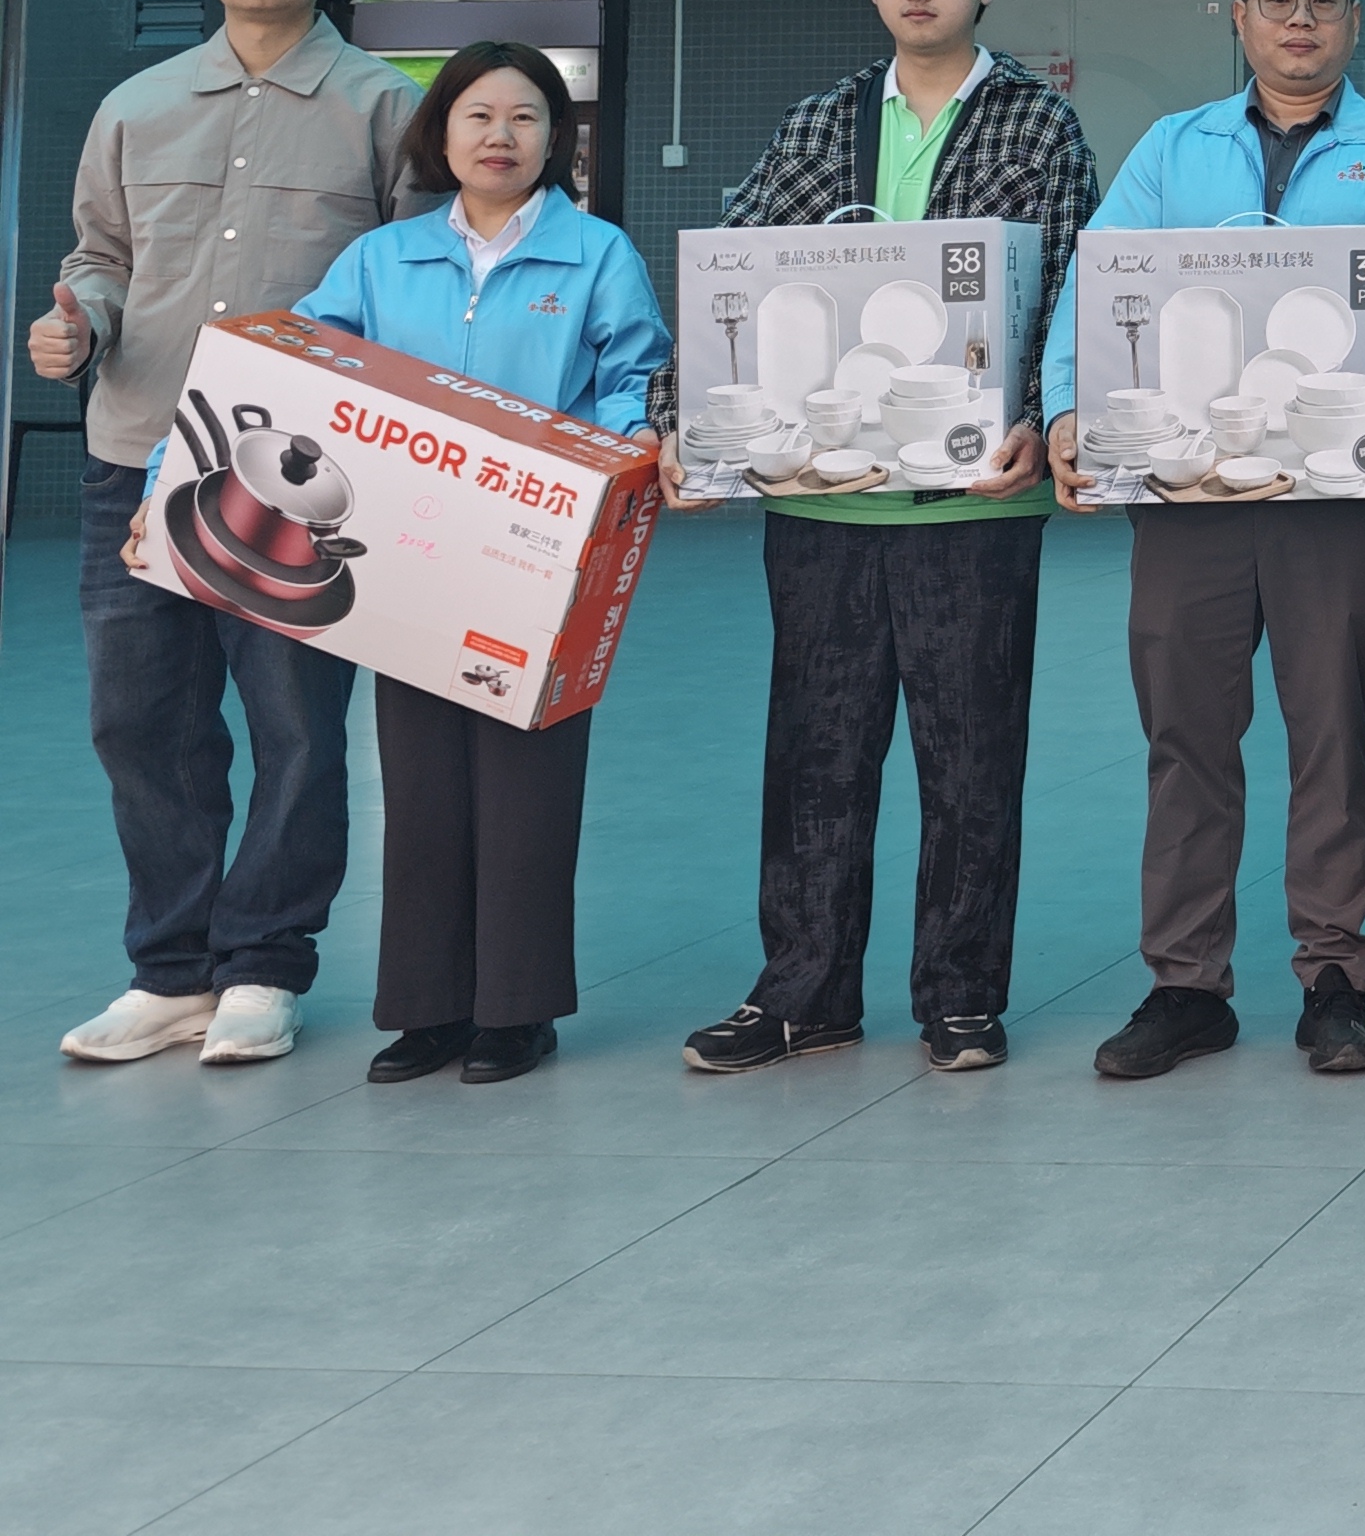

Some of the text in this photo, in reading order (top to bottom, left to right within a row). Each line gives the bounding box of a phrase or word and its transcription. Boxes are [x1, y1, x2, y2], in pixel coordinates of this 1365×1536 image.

[775, 245, 907, 266] 鎏品38头餐具套装
[947, 247, 981, 274] 38
[1177, 252, 1314, 270] 鎏品38头餐具套装
[949, 280, 980, 297] PCS
[427, 372, 553, 424] SUPOR
[552, 419, 647, 458] 苏泊尔
[328, 400, 468, 480] SUPOR
[474, 455, 579, 519] 苏泊尔
[508, 522, 563, 552] 爱家三件套
[612, 479, 662, 597] SUPOR
[587, 602, 624, 690] 苏泊尔
